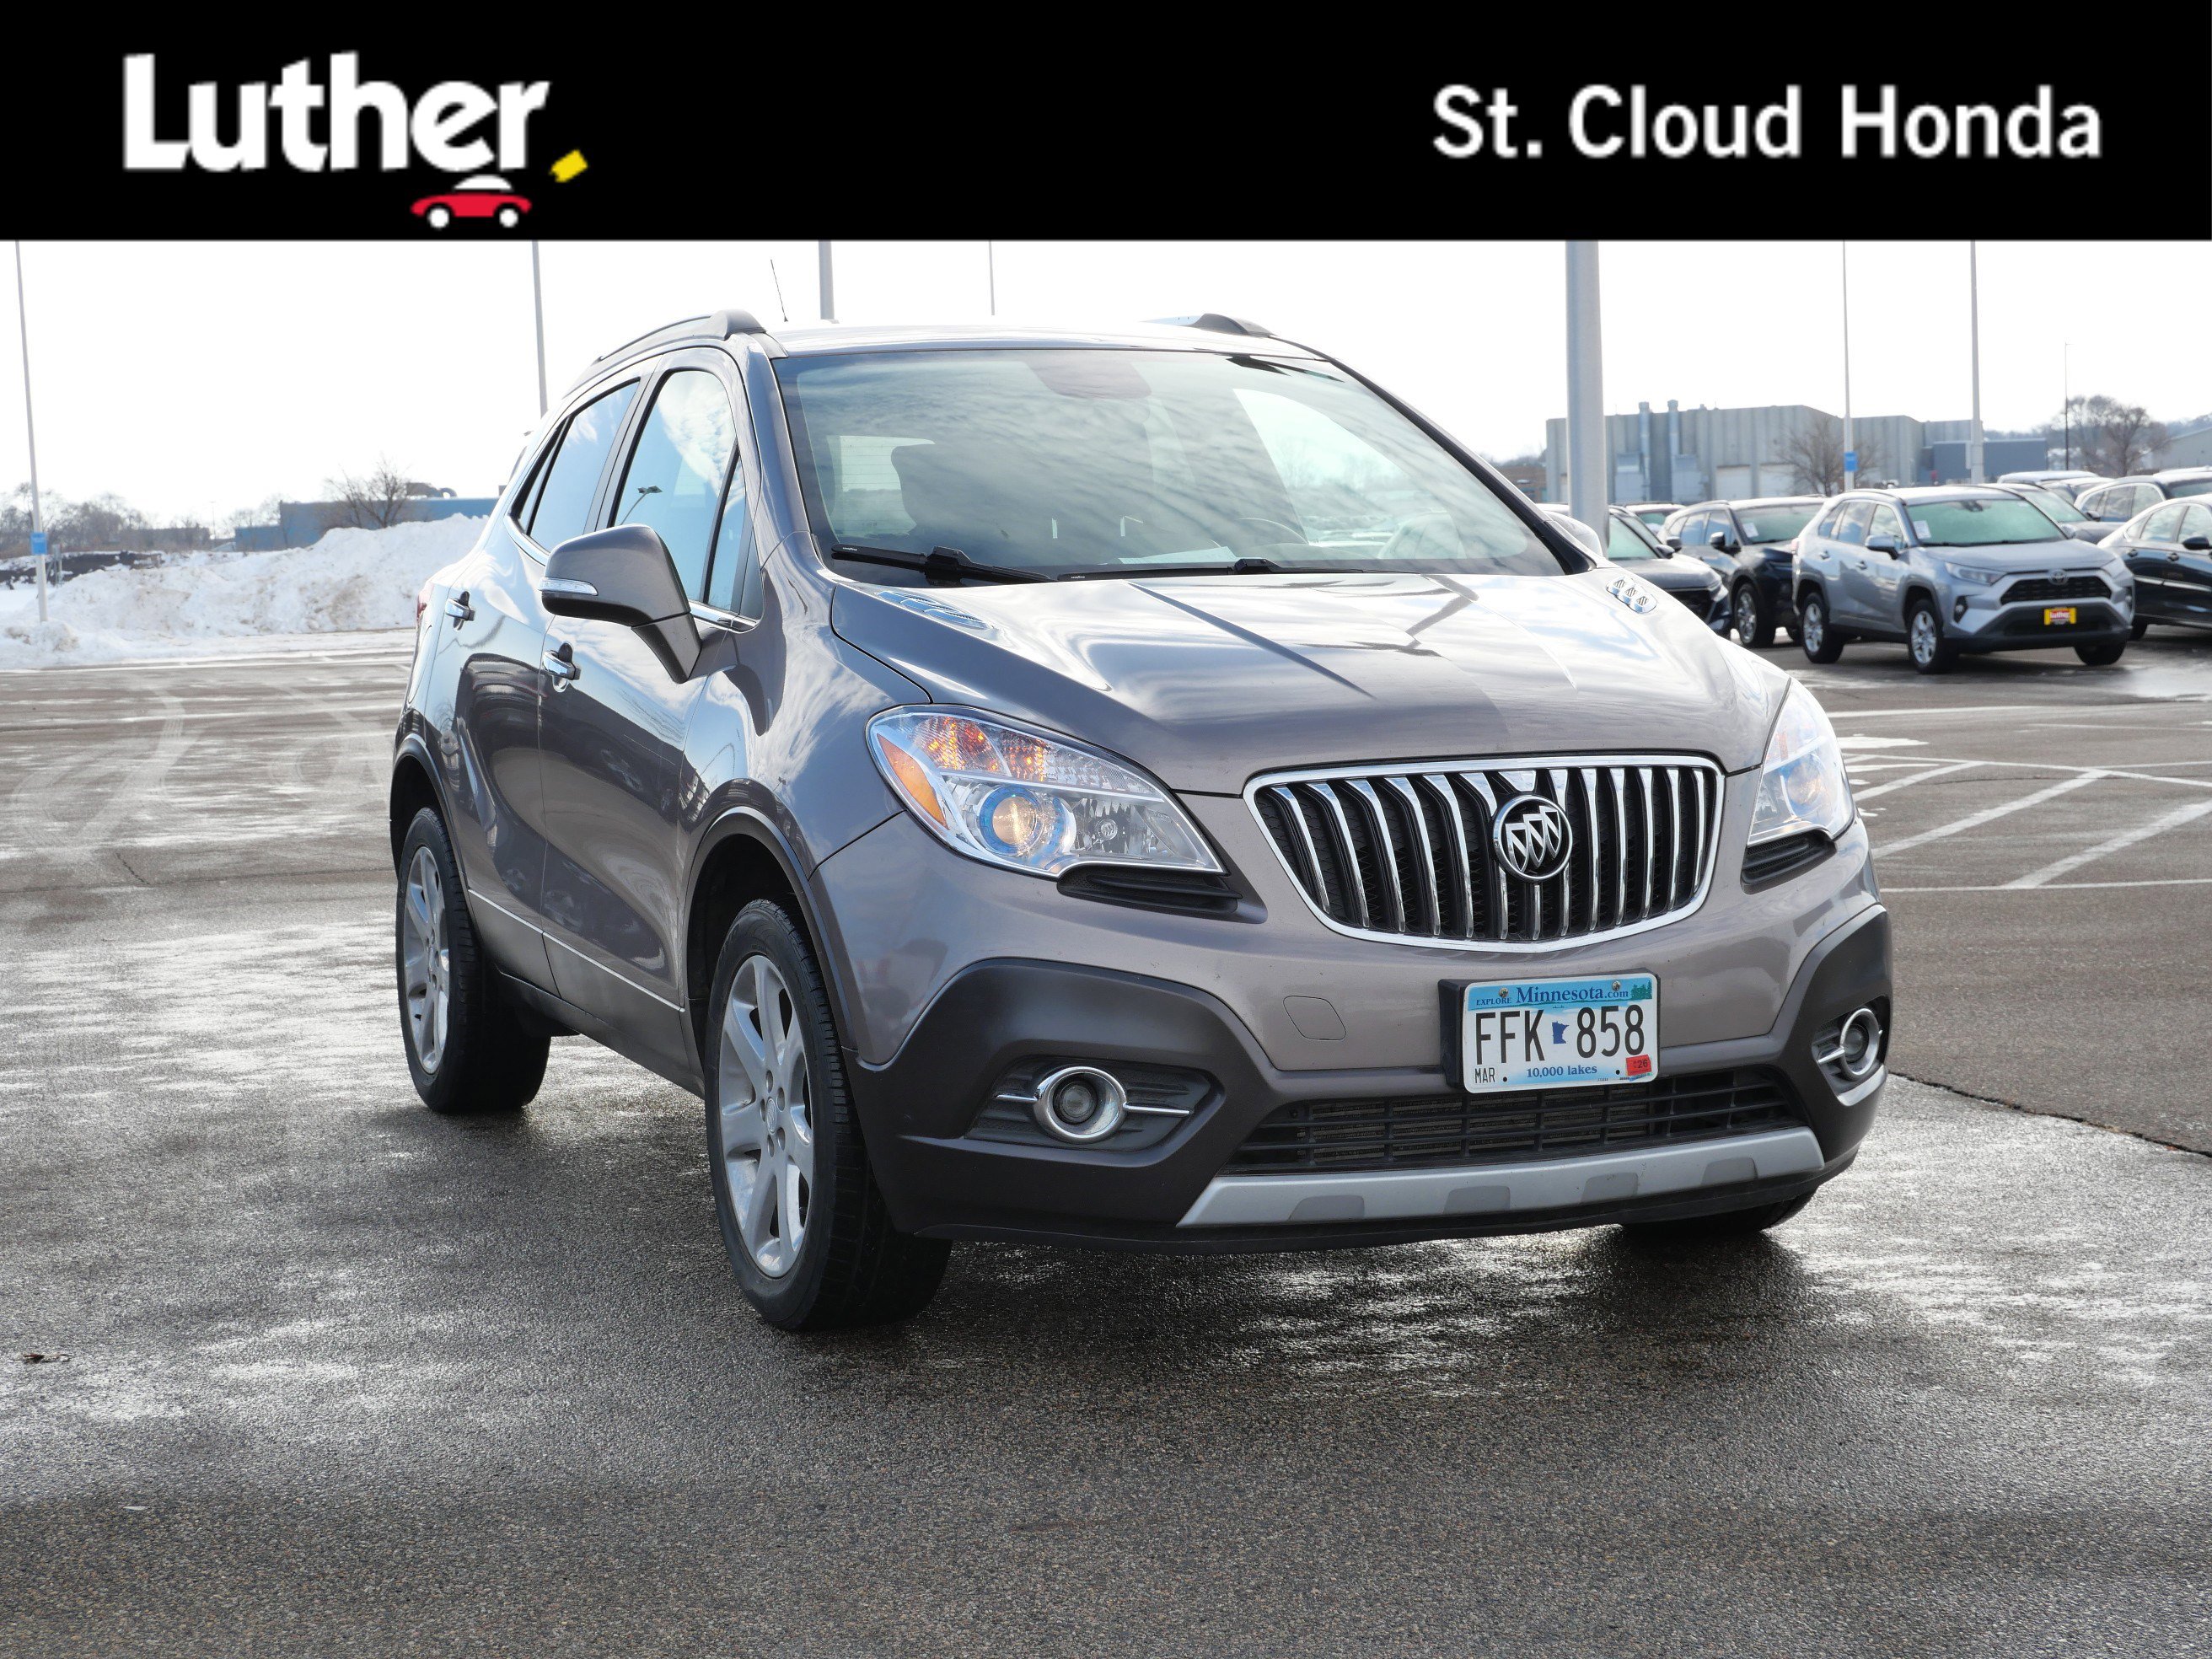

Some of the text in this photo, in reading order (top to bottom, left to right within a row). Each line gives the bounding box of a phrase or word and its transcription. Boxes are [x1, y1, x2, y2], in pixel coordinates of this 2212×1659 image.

[1476, 997, 1512, 1006] EXPLORE
[1475, 1005, 1645, 1066] FFK 858
[1474, 1067, 1495, 1084] MAR
[1527, 1065, 1597, 1078] 10,000 lakes
